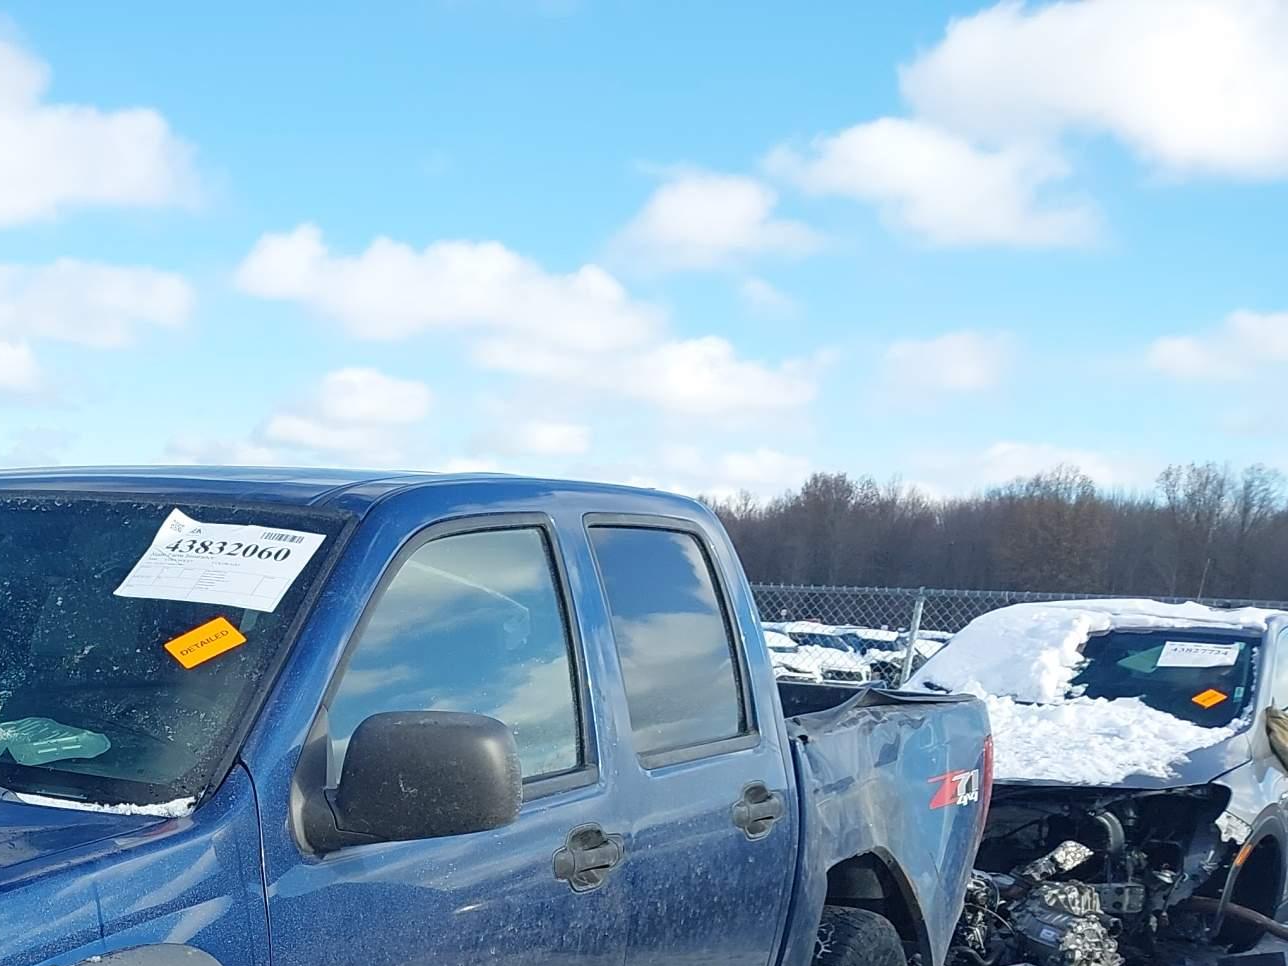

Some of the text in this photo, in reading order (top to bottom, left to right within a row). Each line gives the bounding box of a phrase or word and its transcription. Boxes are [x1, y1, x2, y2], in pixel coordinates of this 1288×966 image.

[165, 538, 291, 562] 43832060
[179, 629, 230, 657] DETAILED
[927, 768, 979, 810] Z71
